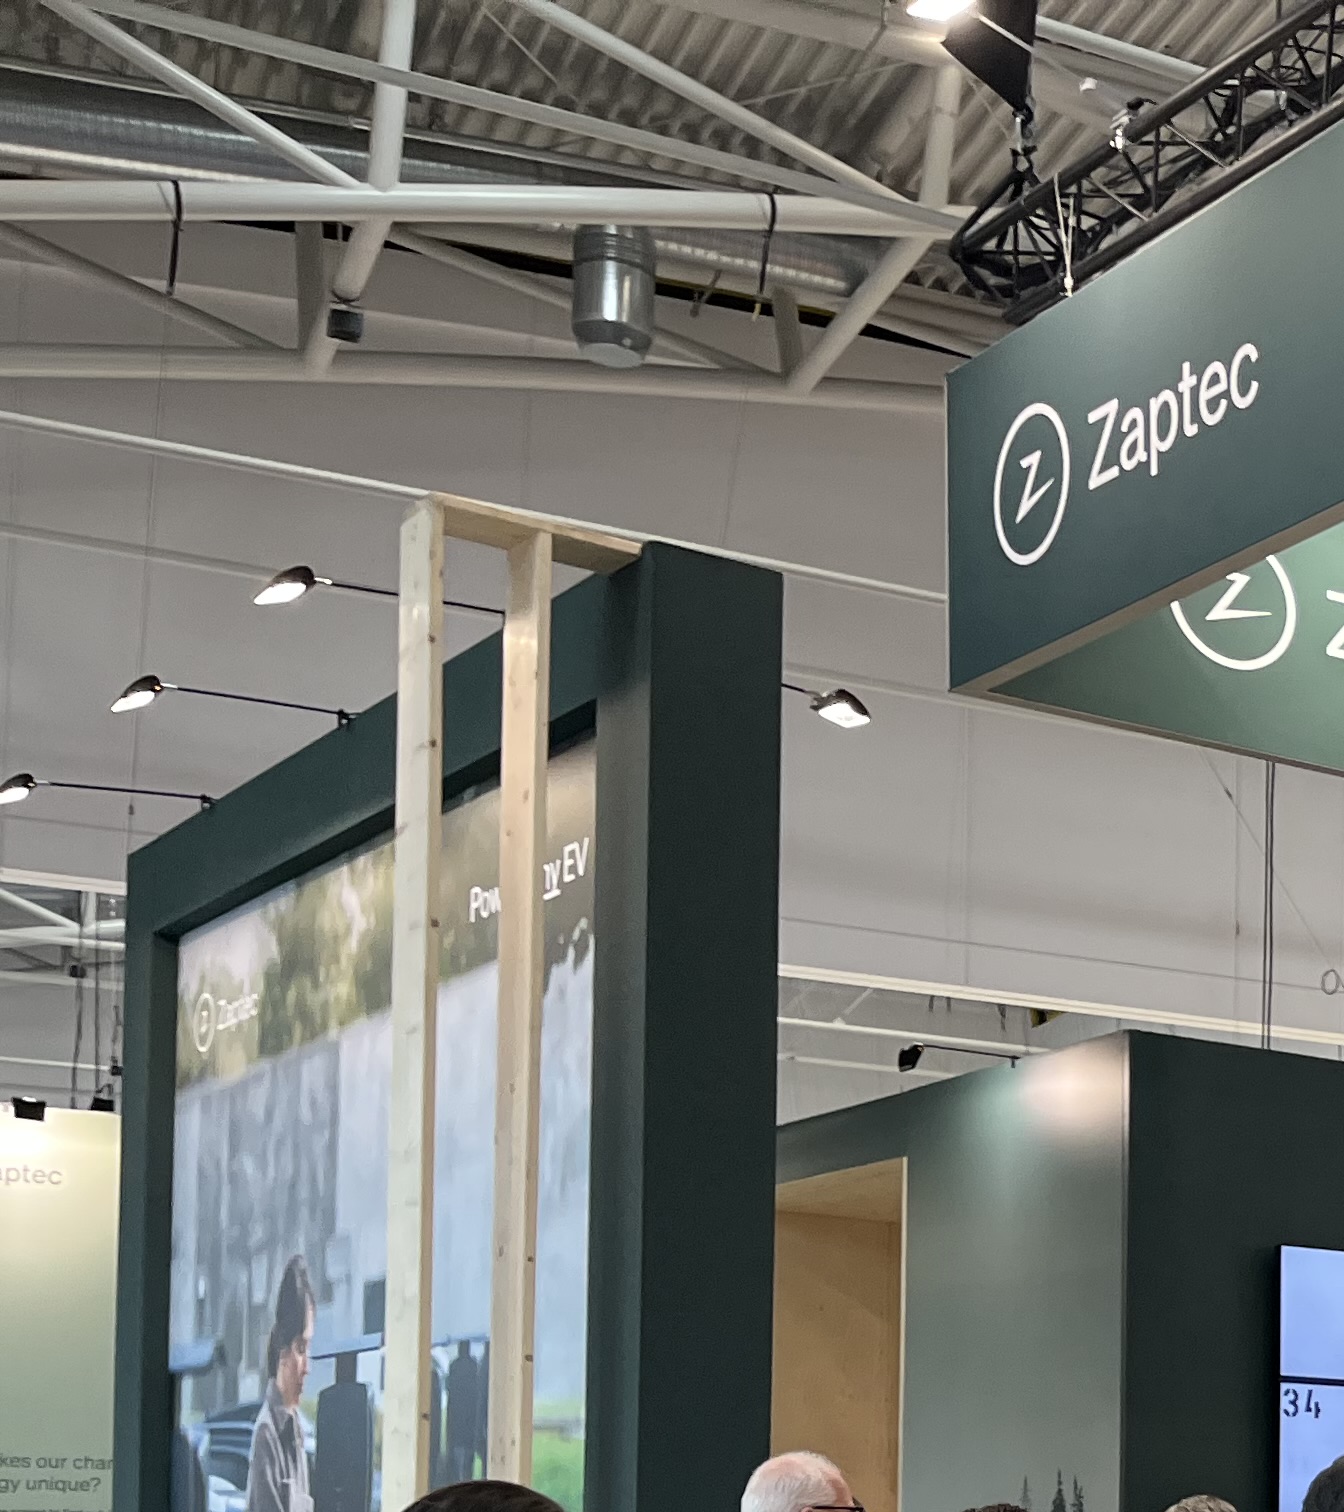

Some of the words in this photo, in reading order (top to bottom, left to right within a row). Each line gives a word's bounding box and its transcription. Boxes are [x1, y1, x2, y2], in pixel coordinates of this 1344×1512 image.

[1087, 343, 1259, 490] Zaptec
[562, 837, 589, 883] EV
[26, 1476, 102, 1494] unique?
